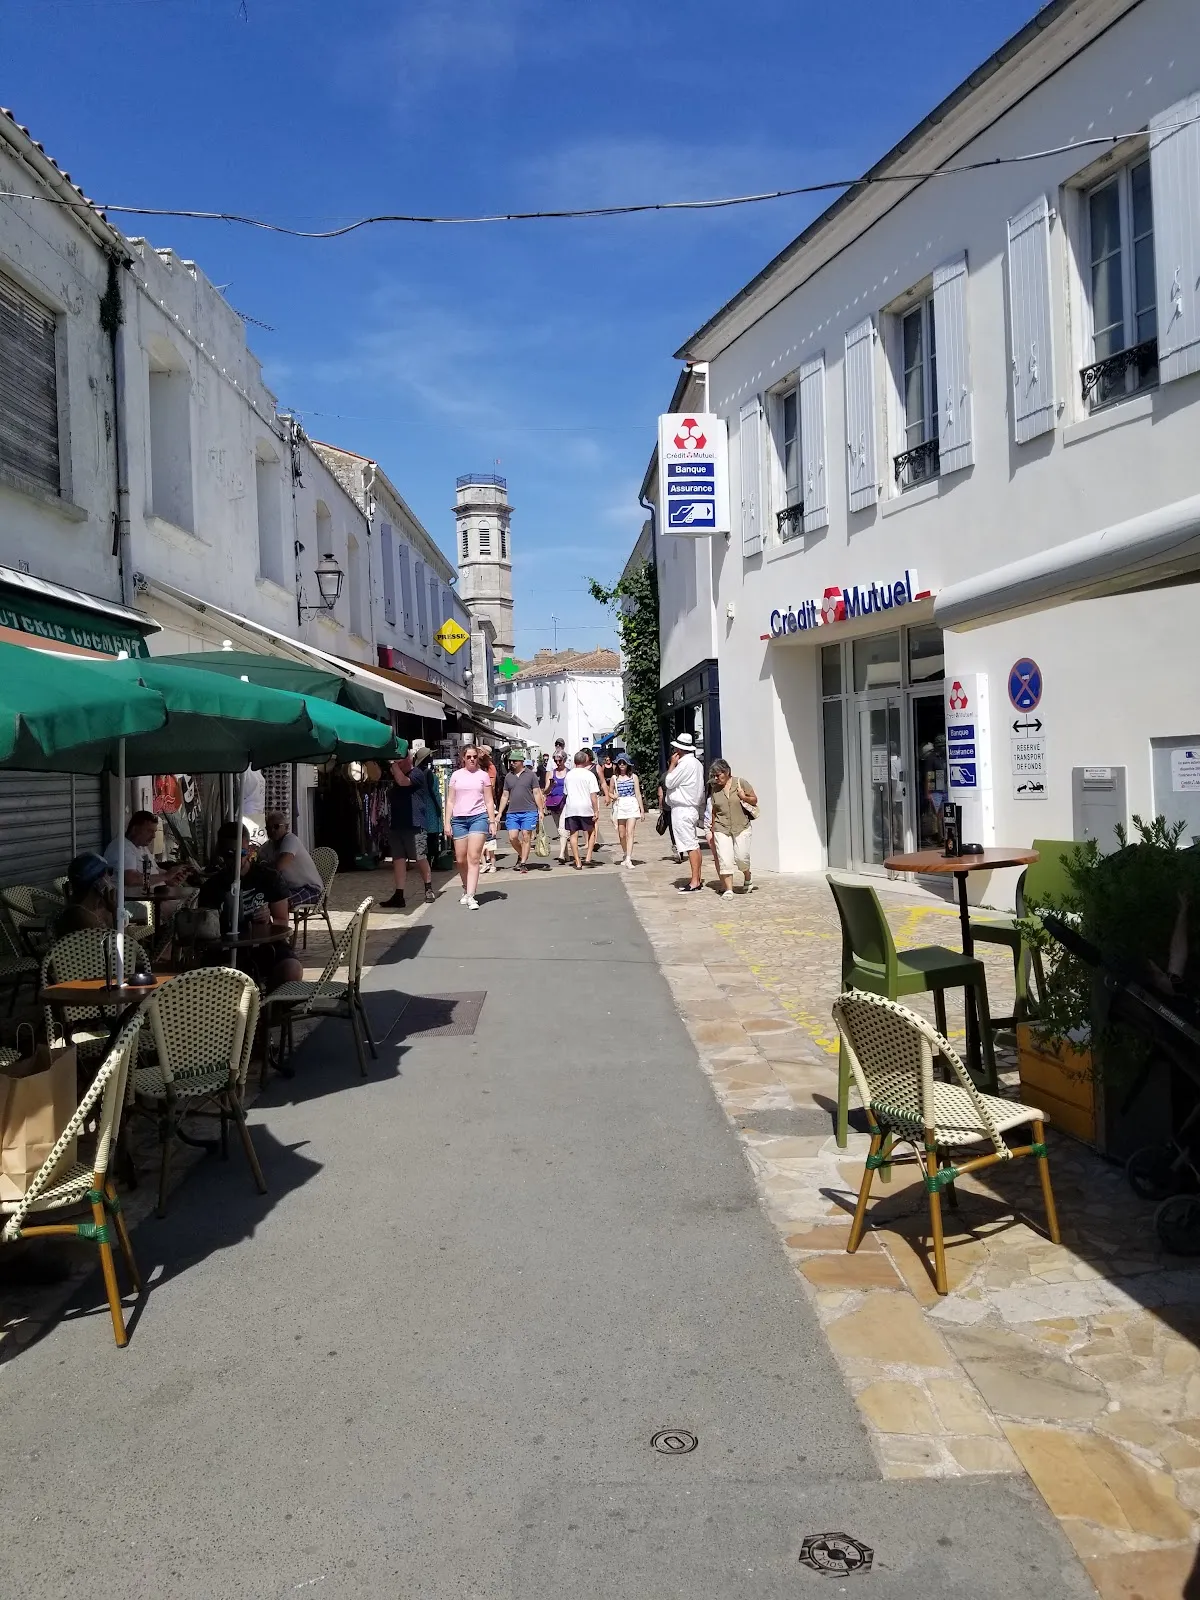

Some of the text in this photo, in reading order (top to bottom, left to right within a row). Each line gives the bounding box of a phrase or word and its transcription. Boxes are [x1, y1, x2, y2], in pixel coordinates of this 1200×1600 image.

[675, 465, 707, 474] Banque
[670, 484, 713, 492] Assurance
[770, 569, 913, 638] Crédit Mutuel
[437, 633, 466, 641] PRESSE
[950, 728, 969, 738] Banque
[949, 747, 974, 756] Assurance
[1013, 752, 1045, 761] TRANSPORT
[1016, 762, 1042, 771] DE FONDS
[833, 1541, 859, 1556] EAU
